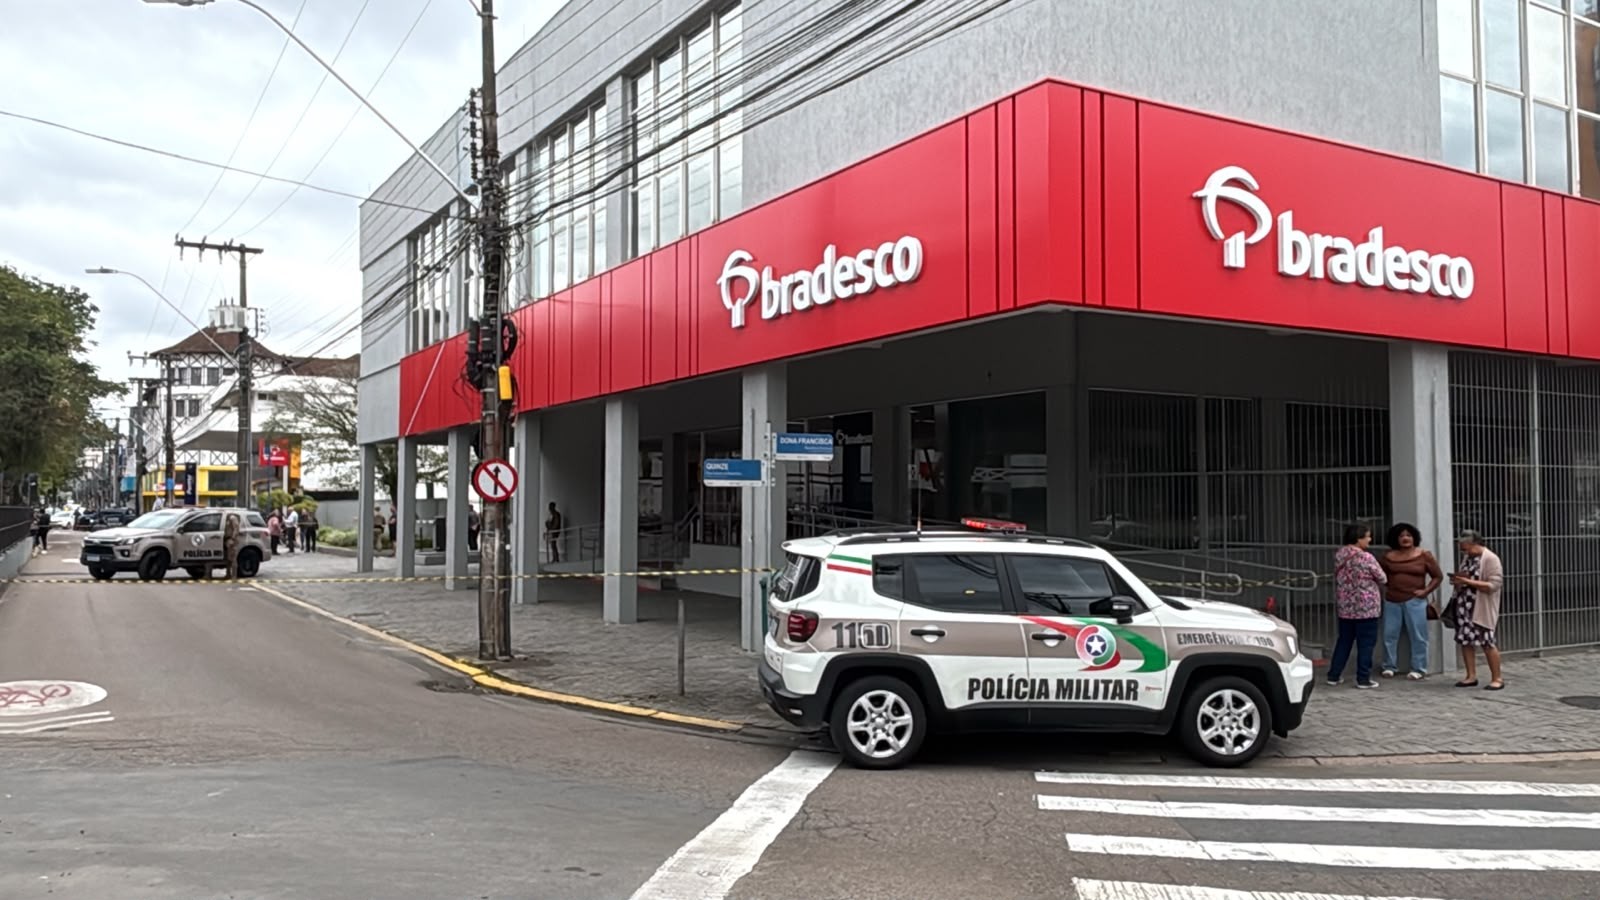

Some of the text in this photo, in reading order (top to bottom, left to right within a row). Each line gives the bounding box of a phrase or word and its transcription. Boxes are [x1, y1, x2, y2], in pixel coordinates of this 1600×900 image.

[1277, 210, 1475, 300] bradesco
[761, 235, 923, 320] bradesco
[799, 437, 833, 445] FRANCISCA
[705, 462, 729, 470] QUINZE
[967, 673, 1139, 701] POLÍCIA MILITAR
